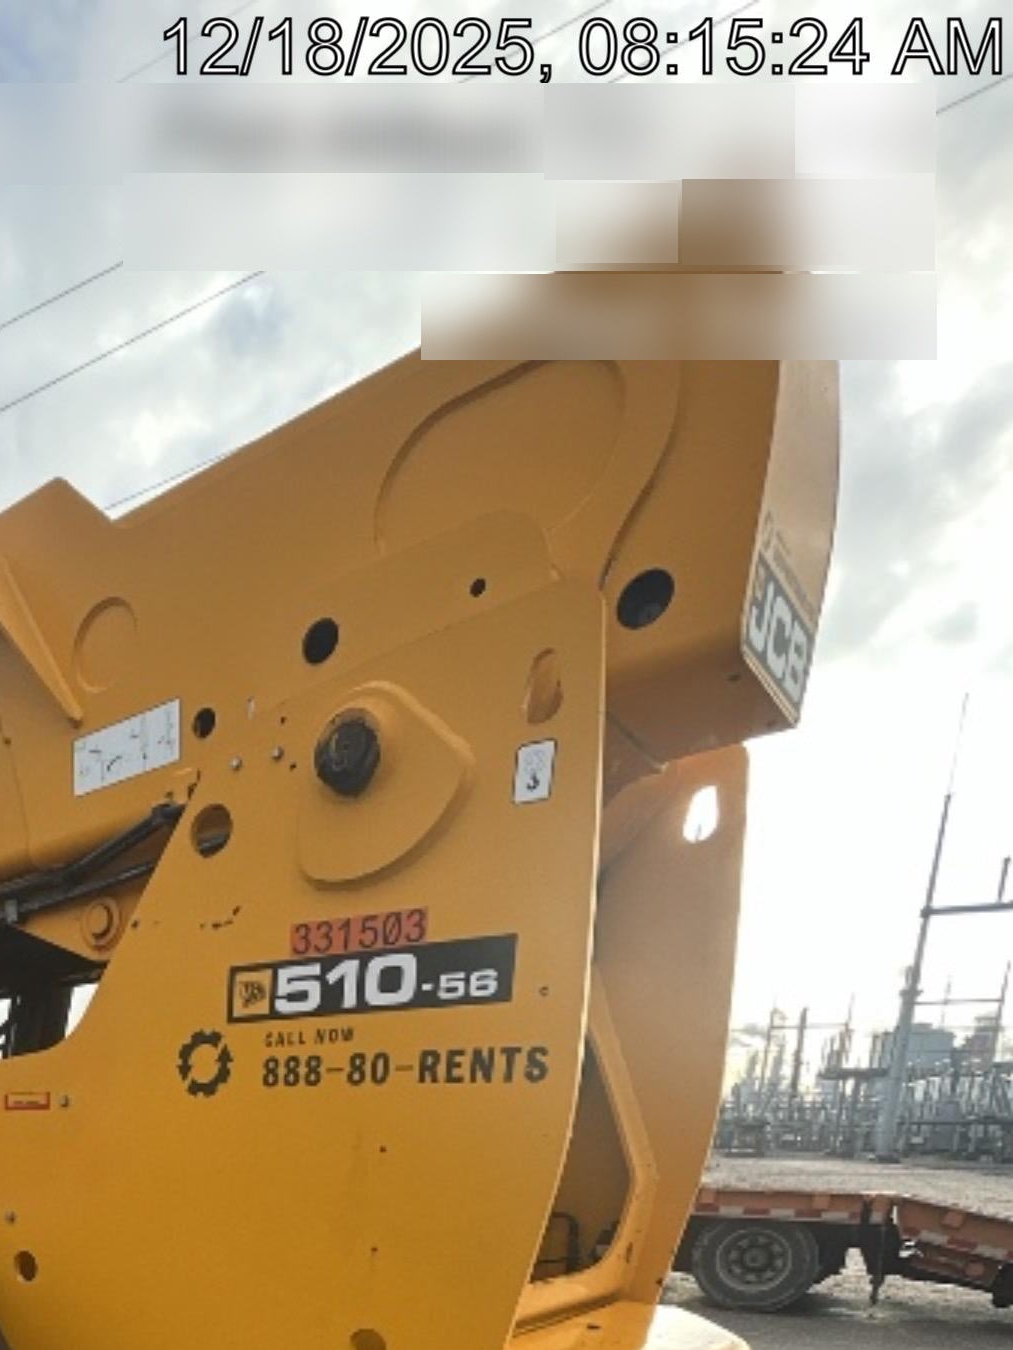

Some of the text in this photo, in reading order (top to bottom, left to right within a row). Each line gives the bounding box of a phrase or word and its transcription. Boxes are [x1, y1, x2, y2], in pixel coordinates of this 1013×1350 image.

[748, 581, 808, 703] JCB
[292, 909, 427, 954] 331503
[274, 953, 499, 1014] 510-56
[264, 1027, 355, 1048] CALL NOW
[262, 1046, 549, 1087] 888-80-RENTS
